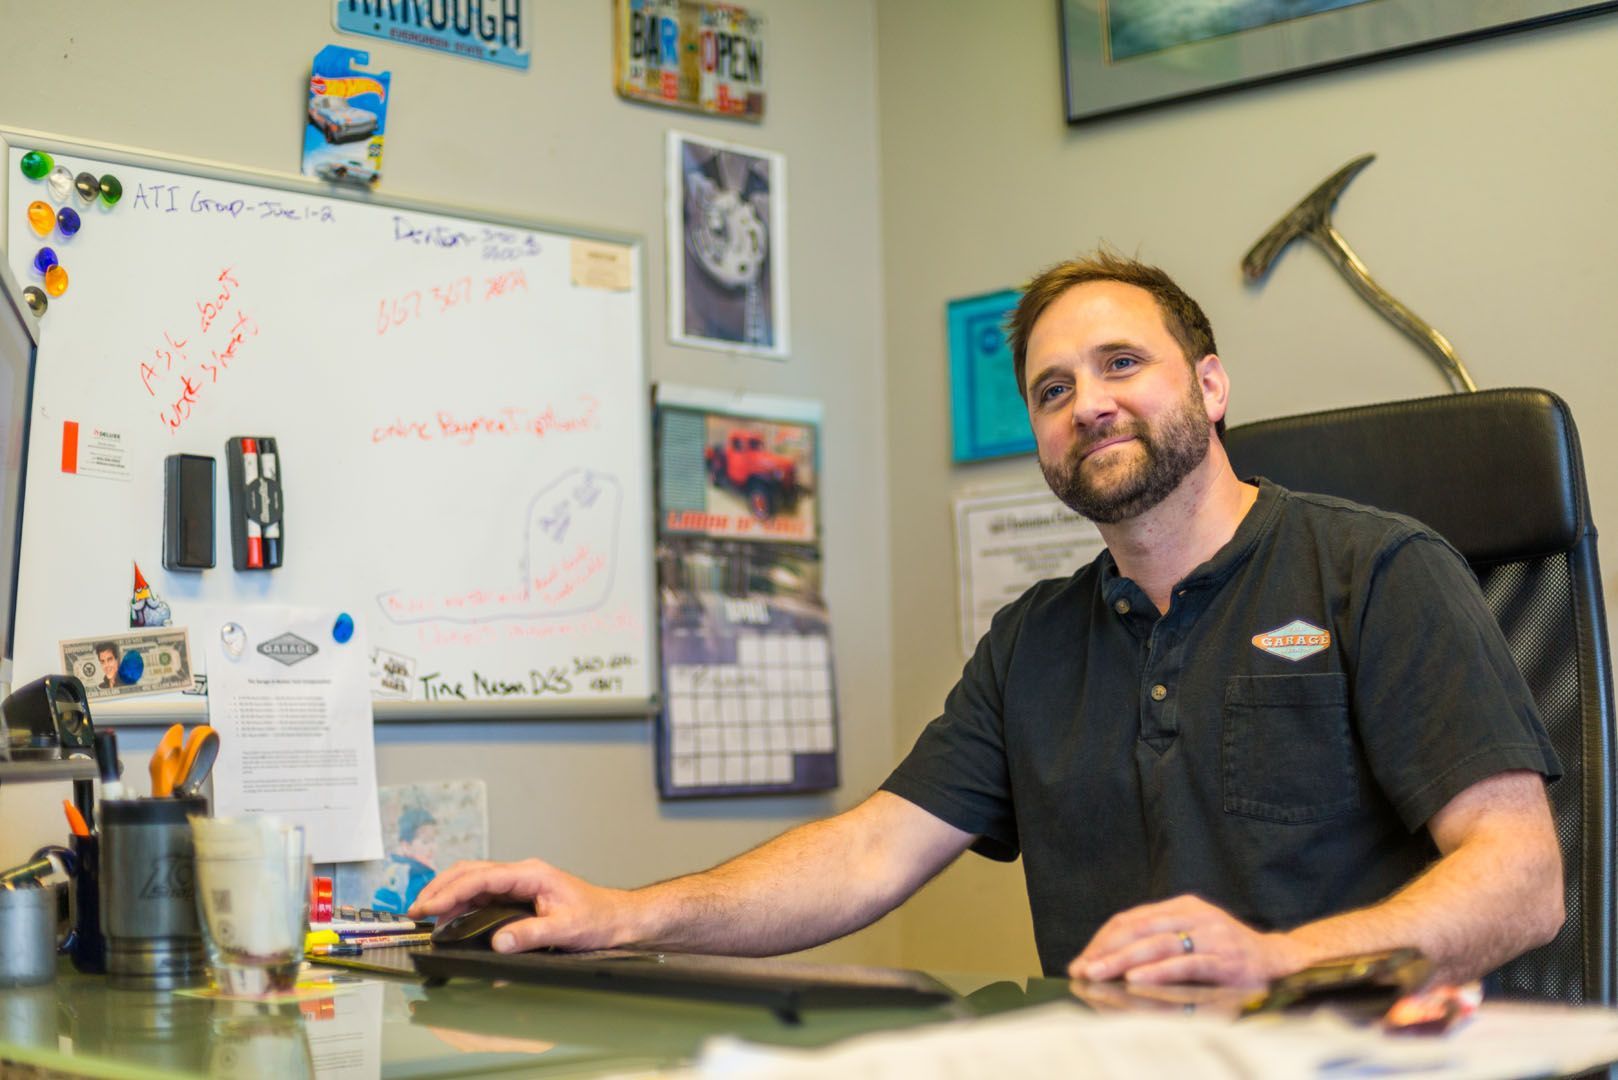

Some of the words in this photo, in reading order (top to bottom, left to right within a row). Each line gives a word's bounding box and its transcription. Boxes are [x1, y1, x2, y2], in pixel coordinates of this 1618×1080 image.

[701, 29, 763, 86] OPEN
[133, 183, 180, 212] ATI
[262, 643, 313, 655] GARAGE
[1261, 634, 1329, 647] GARAGE
